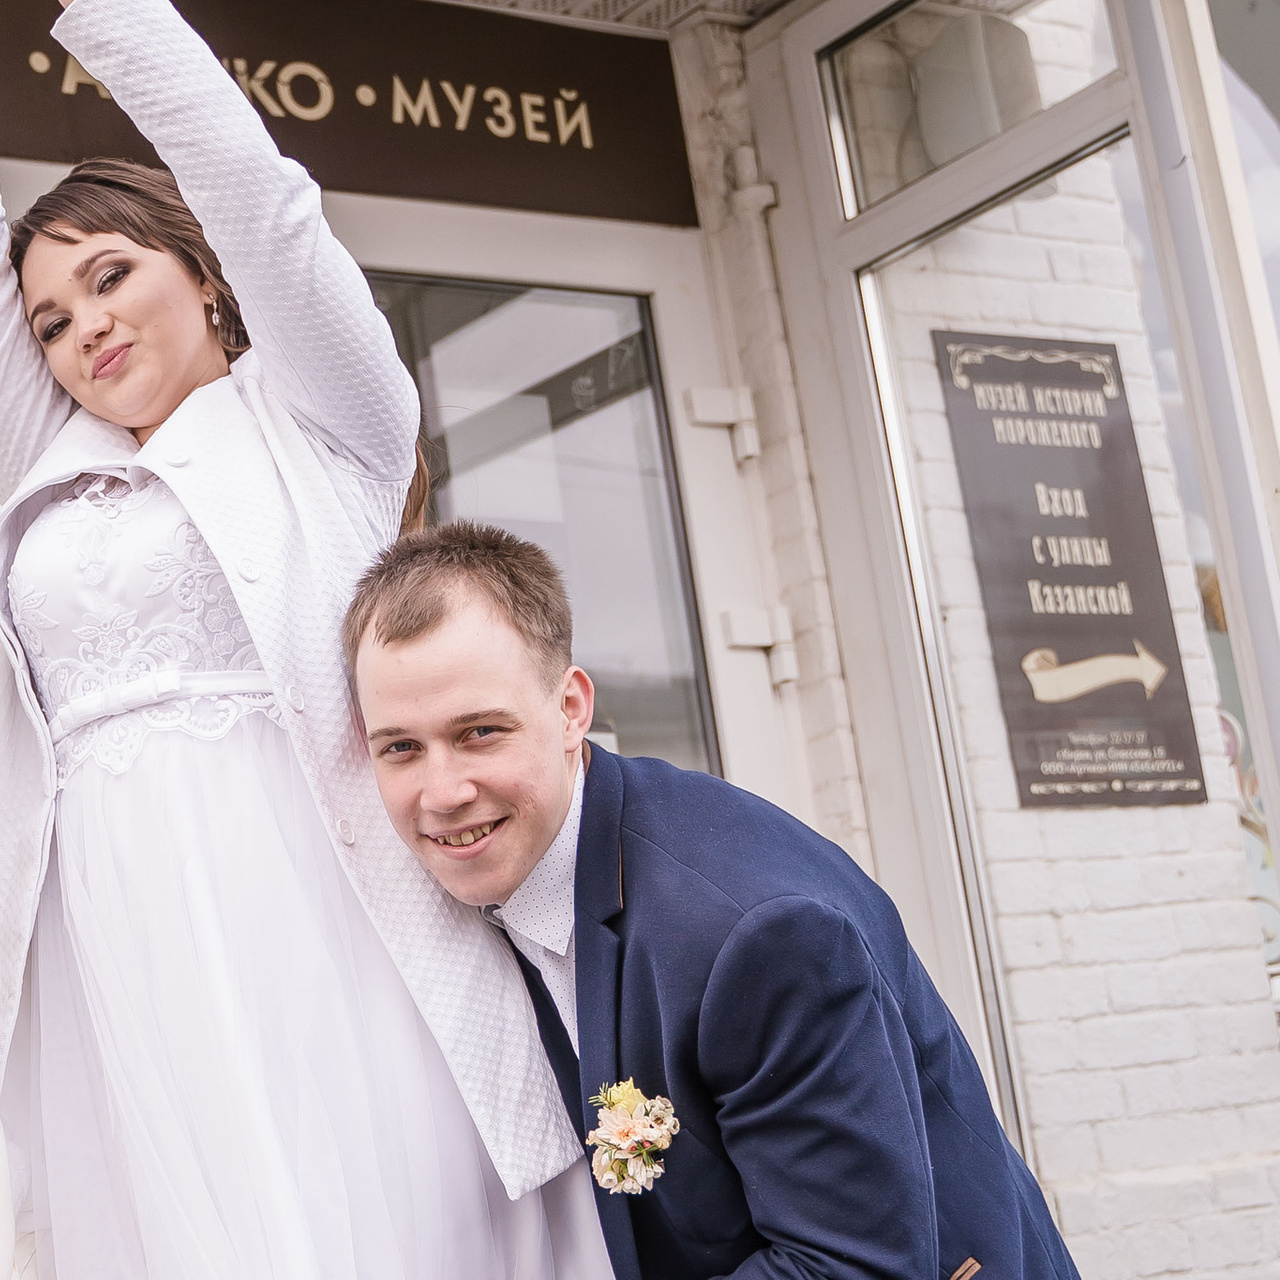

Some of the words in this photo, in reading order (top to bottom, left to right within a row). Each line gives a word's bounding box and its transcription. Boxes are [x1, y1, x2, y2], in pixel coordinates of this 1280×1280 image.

[391, 73, 594, 150] МУЗЕЙ
[1034, 481, 1089, 518] Вход
[1046, 535, 1112, 568] улицы
[1027, 578, 1133, 616] Казанской
